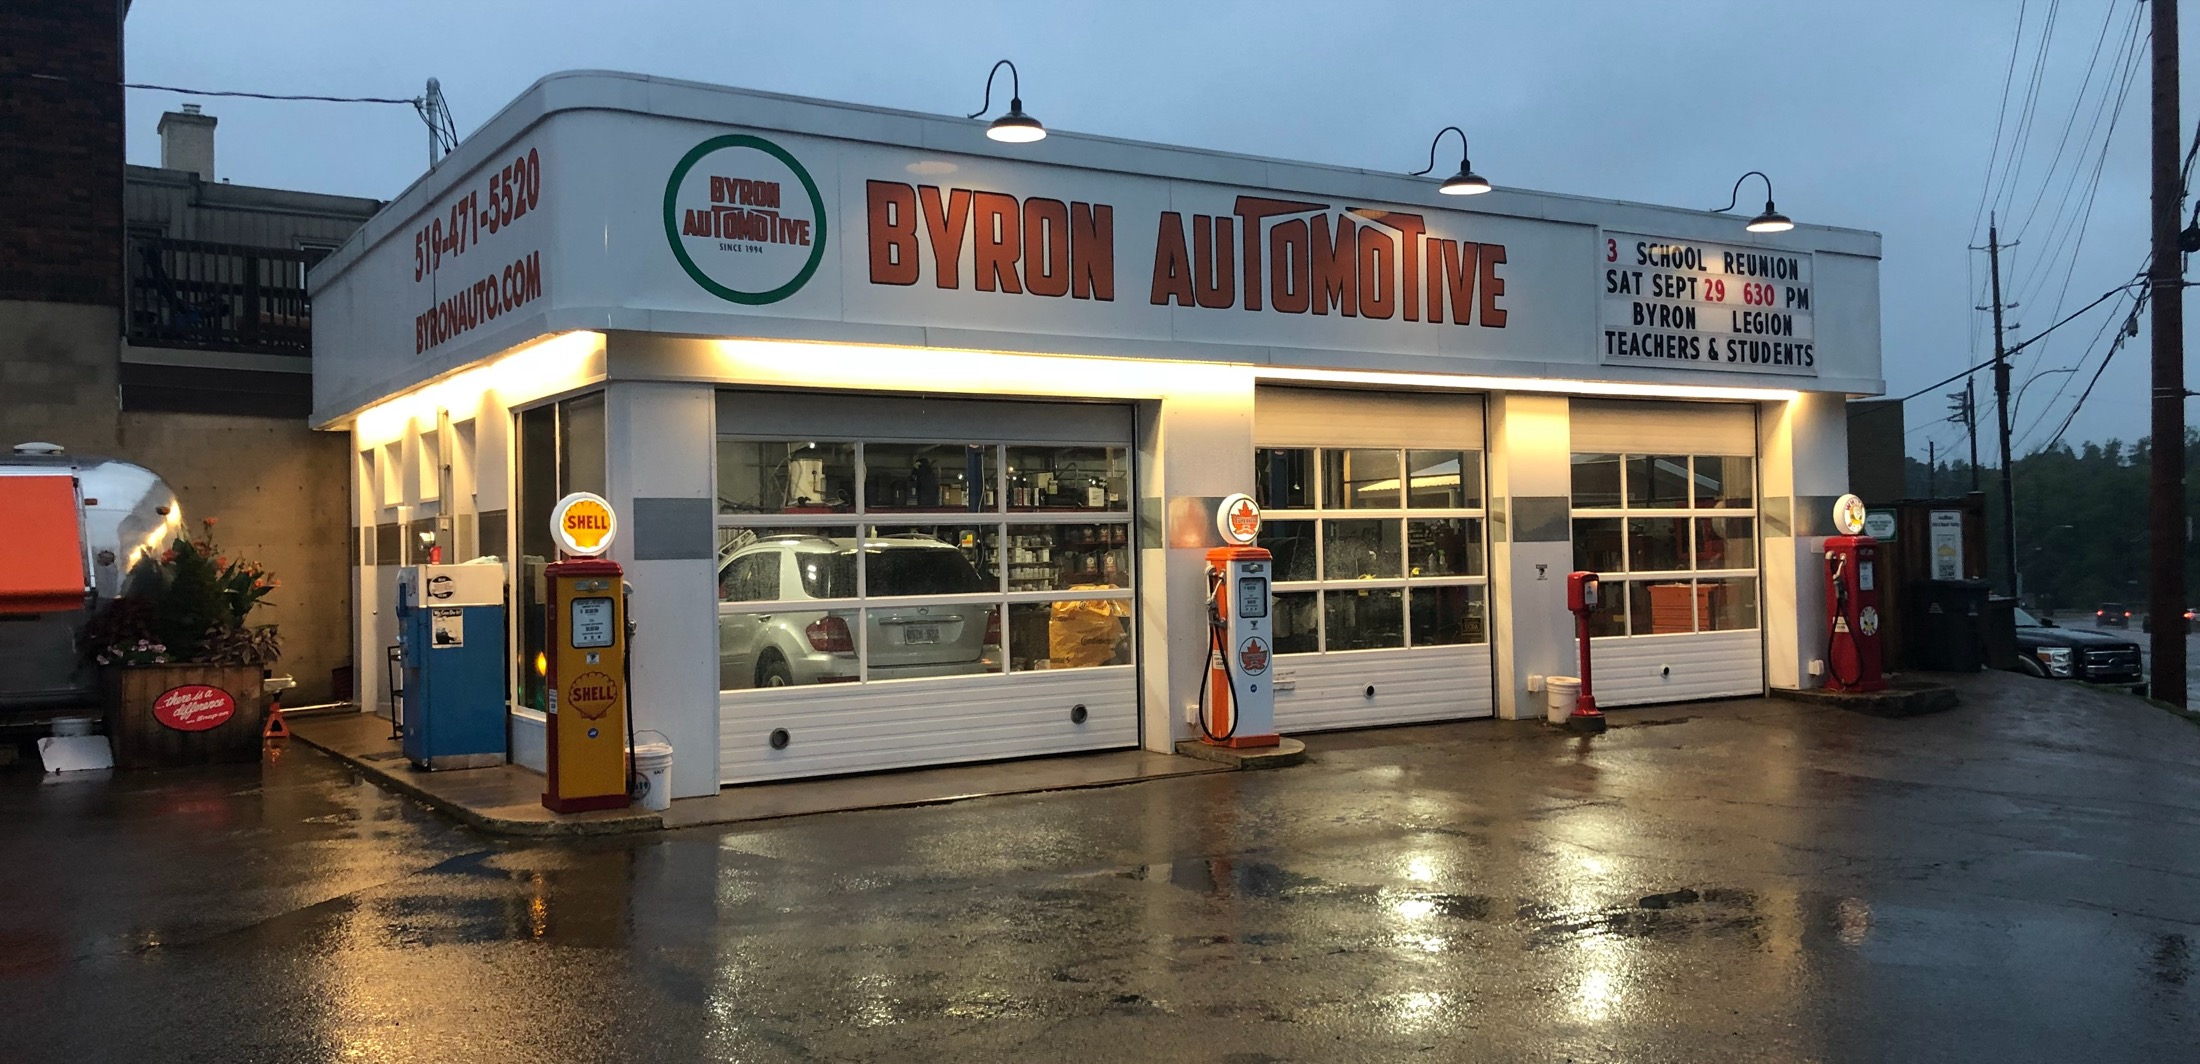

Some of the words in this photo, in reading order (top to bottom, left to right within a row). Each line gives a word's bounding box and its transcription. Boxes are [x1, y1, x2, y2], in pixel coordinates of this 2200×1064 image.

[710, 175, 780, 208] BYRON
[415, 147, 540, 283] 519-471-5520
[683, 205, 811, 246] AUTOMOTIVE
[719, 243, 742, 253] SINCE
[745, 245, 763, 254] 1994
[866, 179, 1114, 302] BYRON
[1150, 196, 1508, 328] AUTOMOTIVE
[1606, 238, 1618, 262] 3
[1636, 241, 1707, 272] SCHOOL
[1723, 250, 1799, 281] REUNION
[416, 250, 542, 355] BYRONAUTO.COM
[1606, 269, 1643, 295] SAT
[1652, 273, 1698, 300] SEPT
[1704, 278, 1726, 302] 29
[1743, 282, 1775, 307] 630
[1786, 286, 1809, 310] PM
[1633, 301, 1696, 330] BYRON
[1732, 310, 1793, 337] LEGION
[1604, 330, 1700, 360] TEACHERS
[1708, 337, 1719, 361] &
[1726, 339, 1814, 367] STUDENTS
[567, 515, 608, 530] SHELL
[173, 698, 225, 720] difference
[204, 690, 213, 698] a
[573, 686, 614, 701] SHELL
